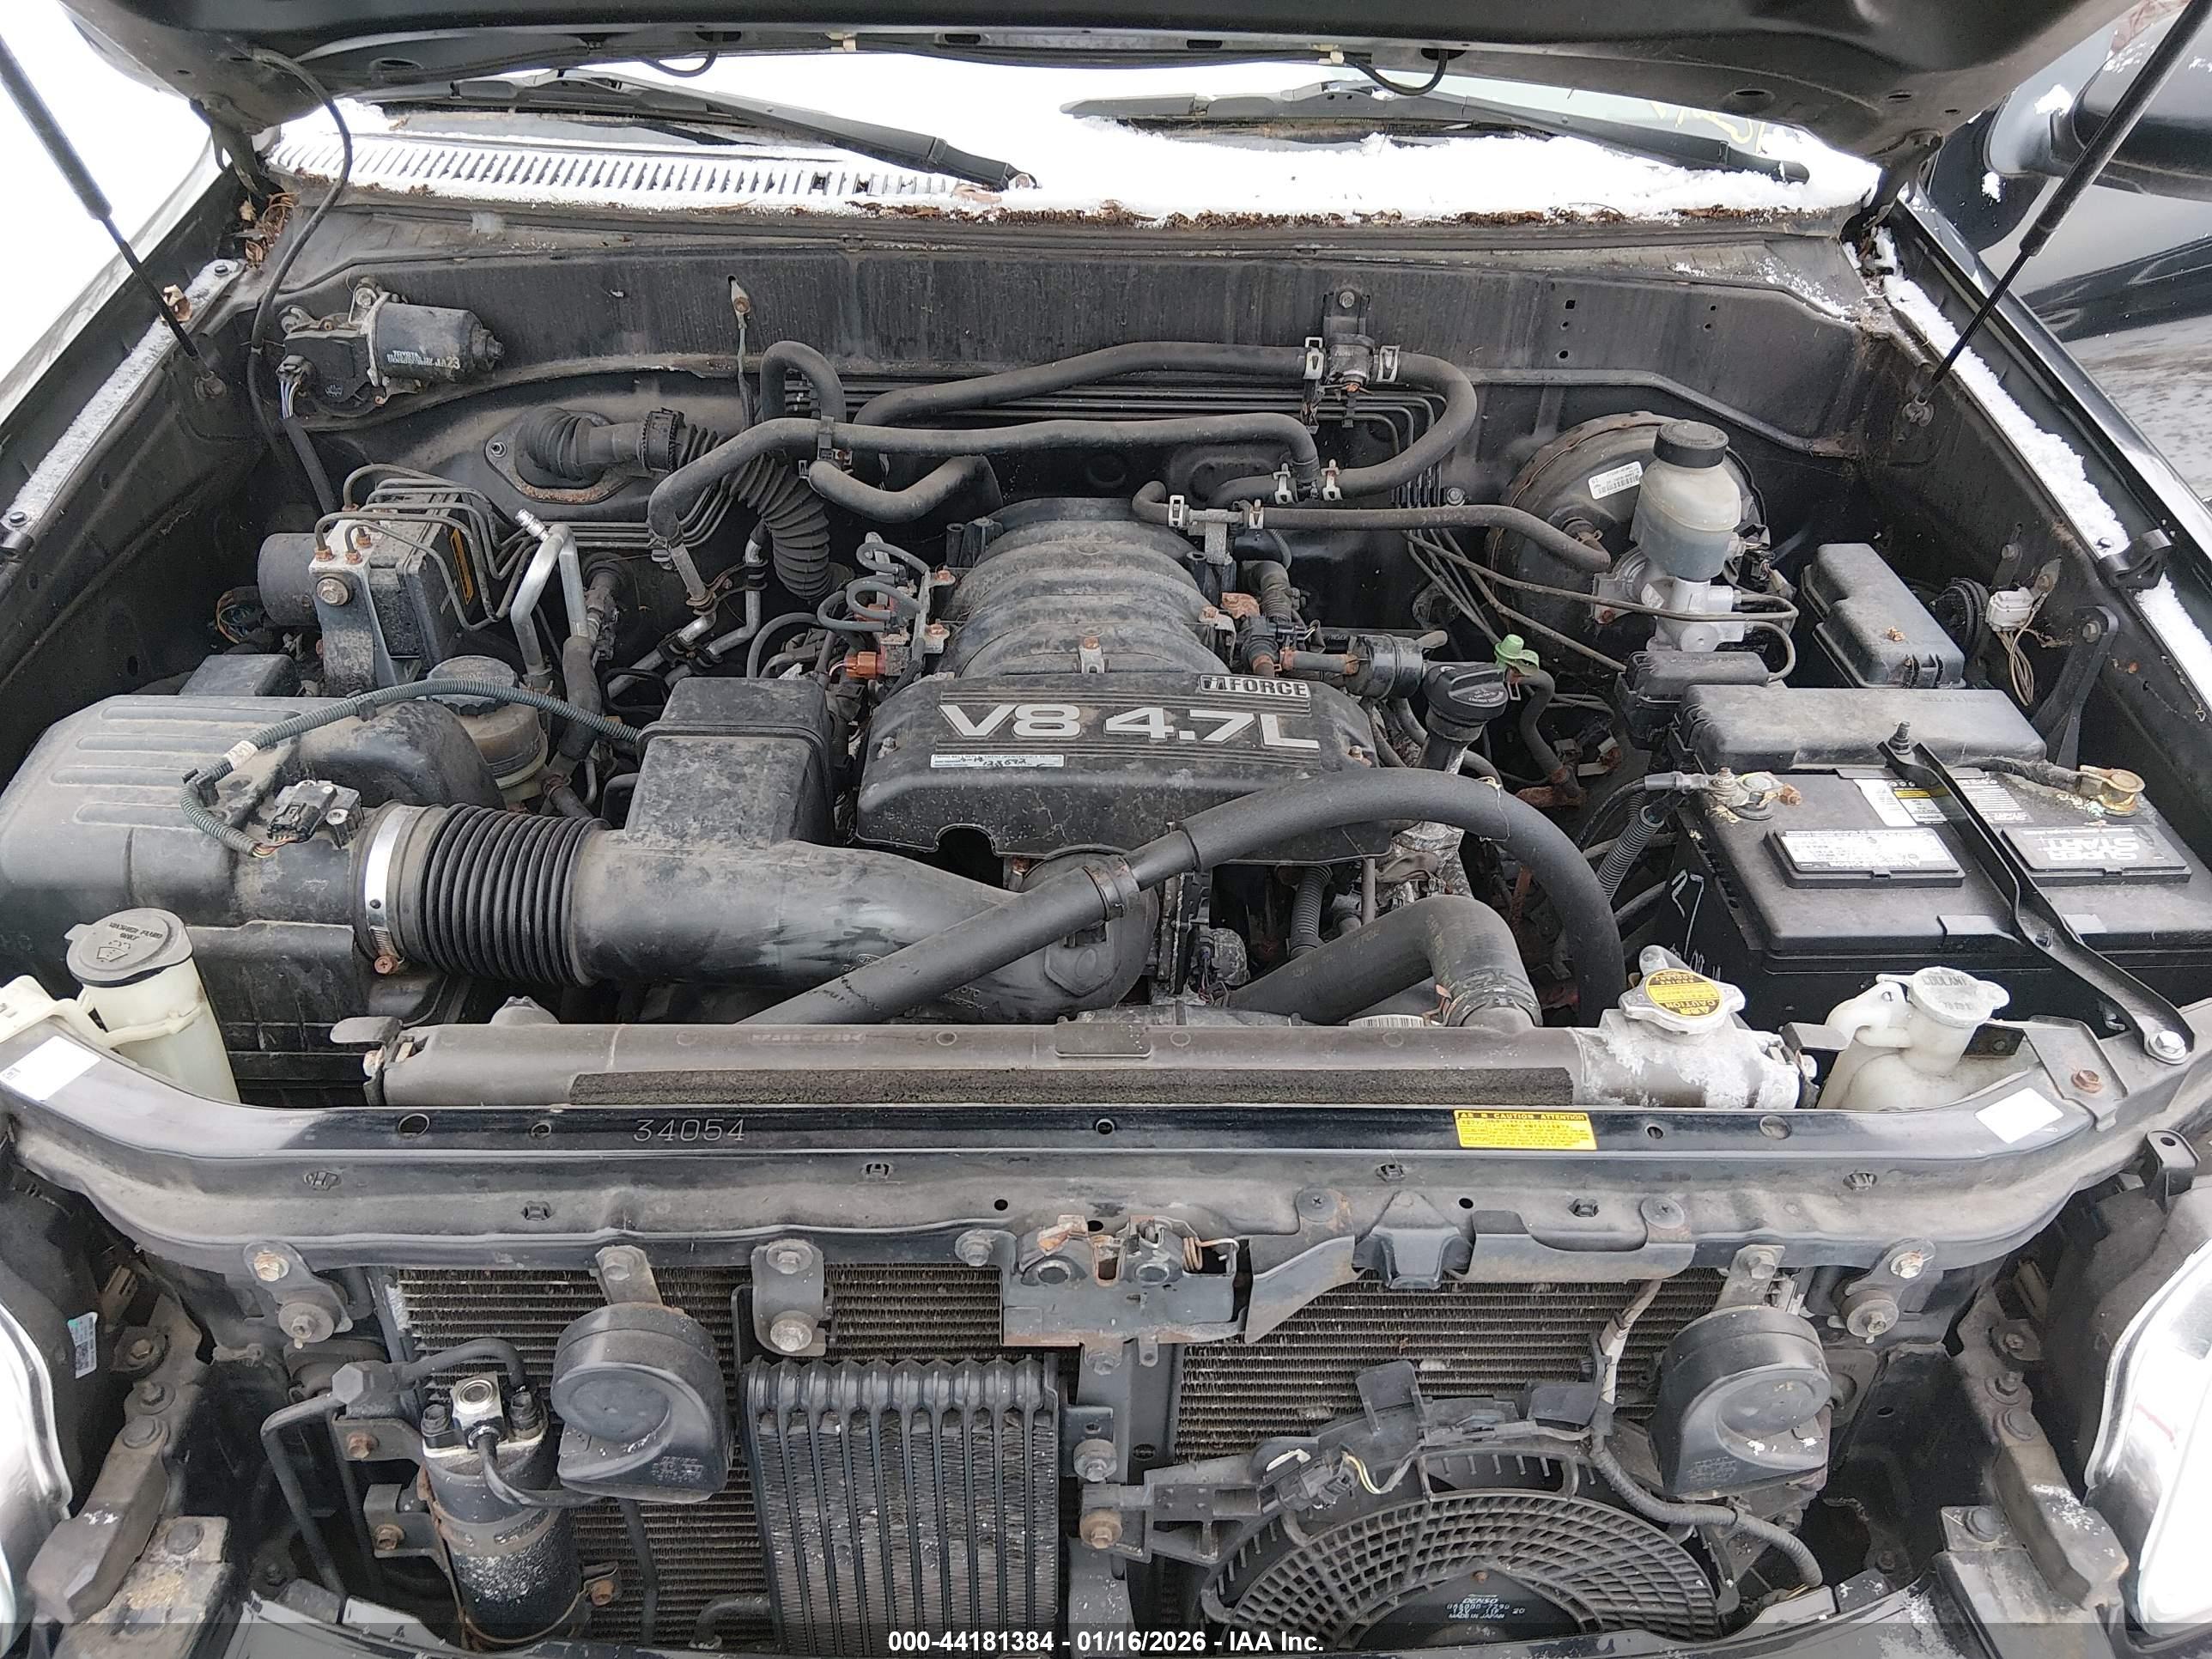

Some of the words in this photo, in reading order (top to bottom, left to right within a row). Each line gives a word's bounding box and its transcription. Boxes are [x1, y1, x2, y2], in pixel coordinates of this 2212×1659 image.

[939, 703, 1080, 738] V8
[1104, 706, 1320, 750] 4.7L
[109, 922, 139, 933] WASHER
[140, 930, 163, 939] FLUID
[1922, 975, 1967, 987] COOLANT
[1665, 1000, 1716, 1009] CAUTION
[633, 1119, 745, 1142] 34054
